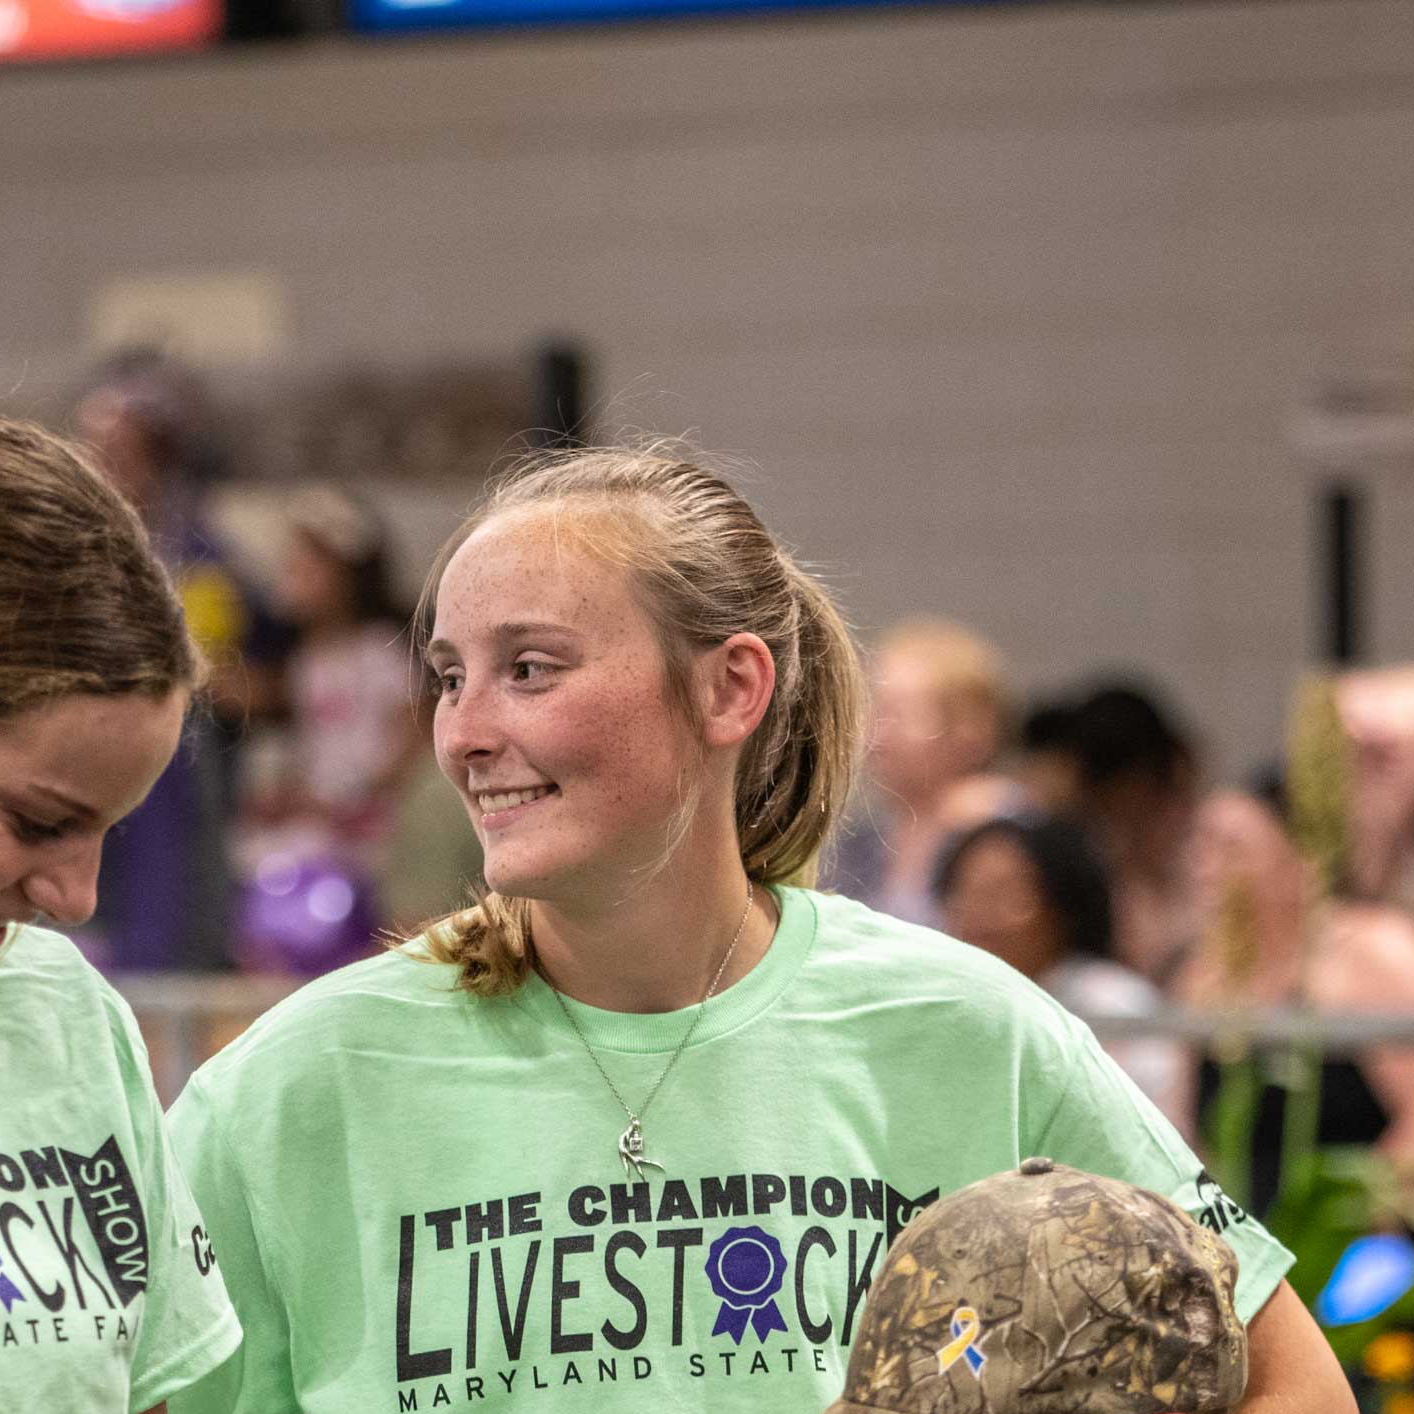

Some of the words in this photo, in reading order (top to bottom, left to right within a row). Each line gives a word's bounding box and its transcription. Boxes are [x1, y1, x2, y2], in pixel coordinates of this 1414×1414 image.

[80, 1159, 148, 1284] SHOW
[424, 1191, 542, 1250] THE
[567, 1173, 885, 1226] CHAMPION
[398, 1356, 653, 1414] MARYLAND
[690, 1348, 828, 1378] STATE
